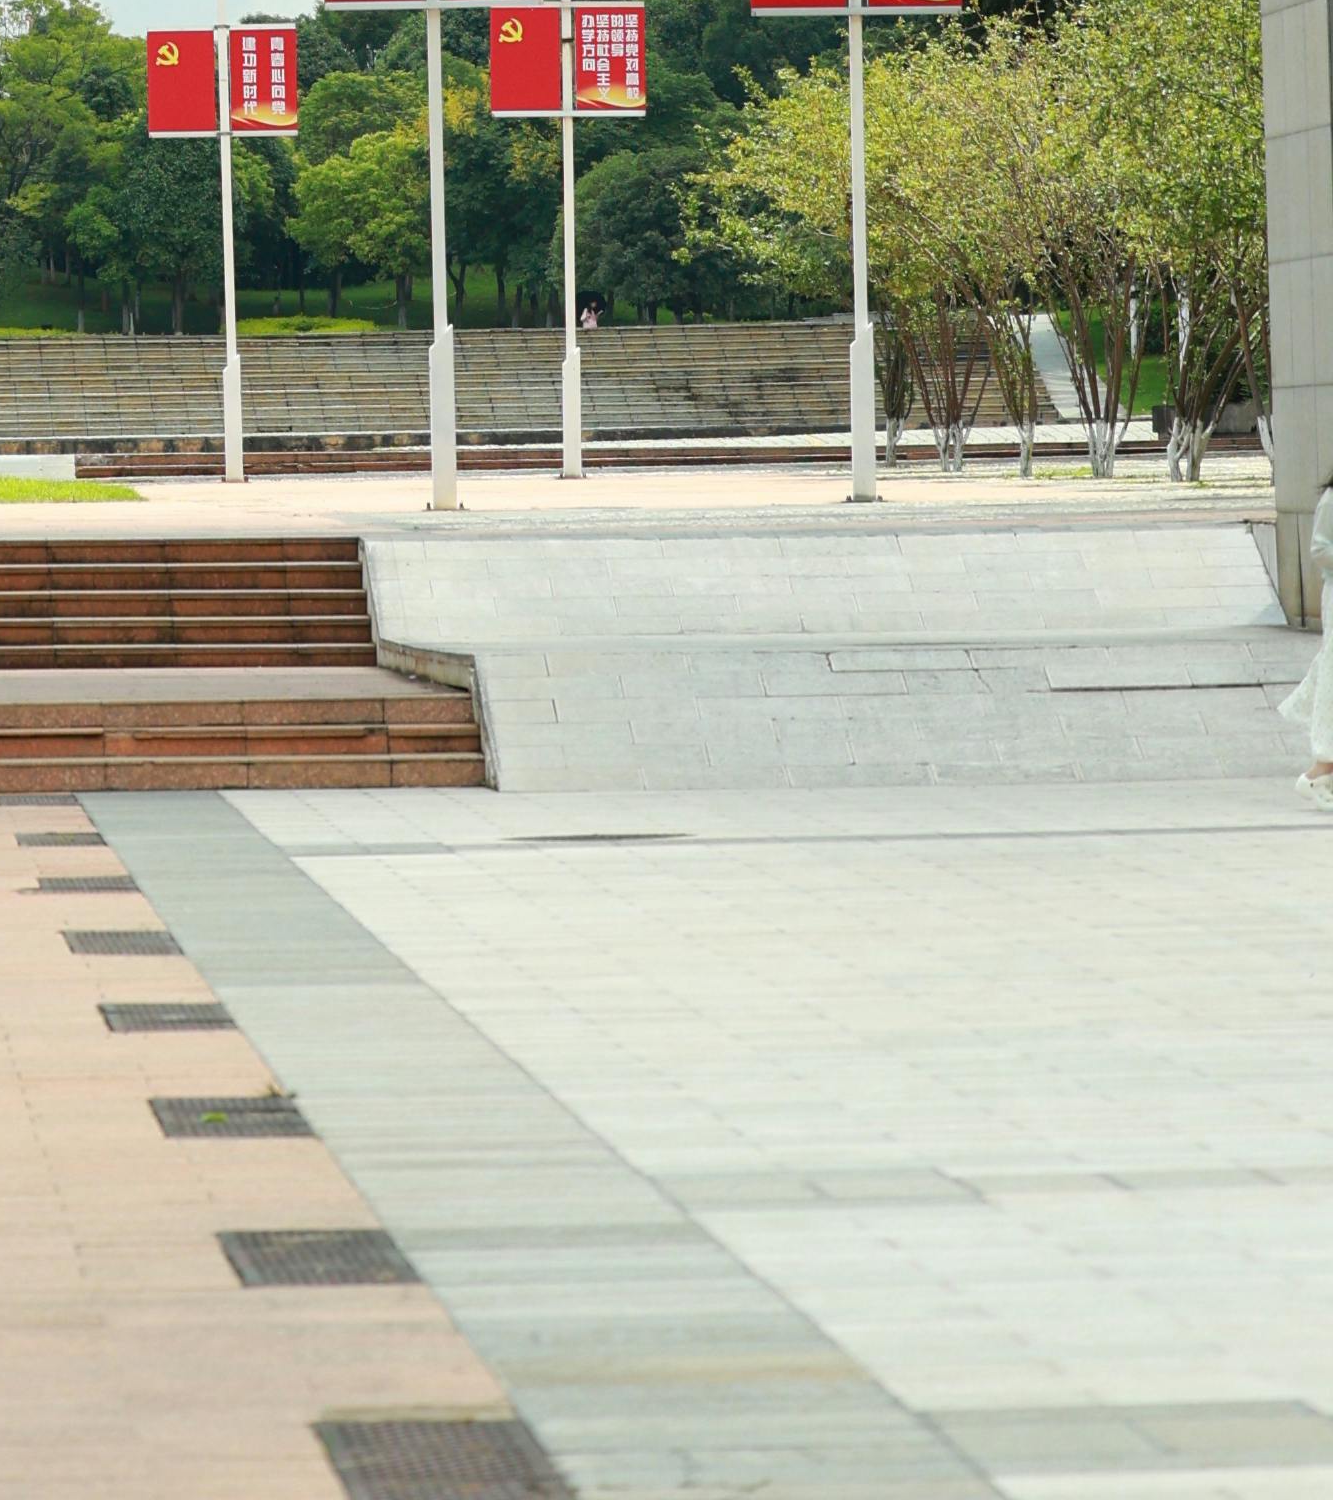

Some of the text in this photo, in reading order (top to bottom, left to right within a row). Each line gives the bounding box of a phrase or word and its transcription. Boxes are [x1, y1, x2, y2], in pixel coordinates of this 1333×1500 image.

[242, 36, 257, 115] 建功新时代
